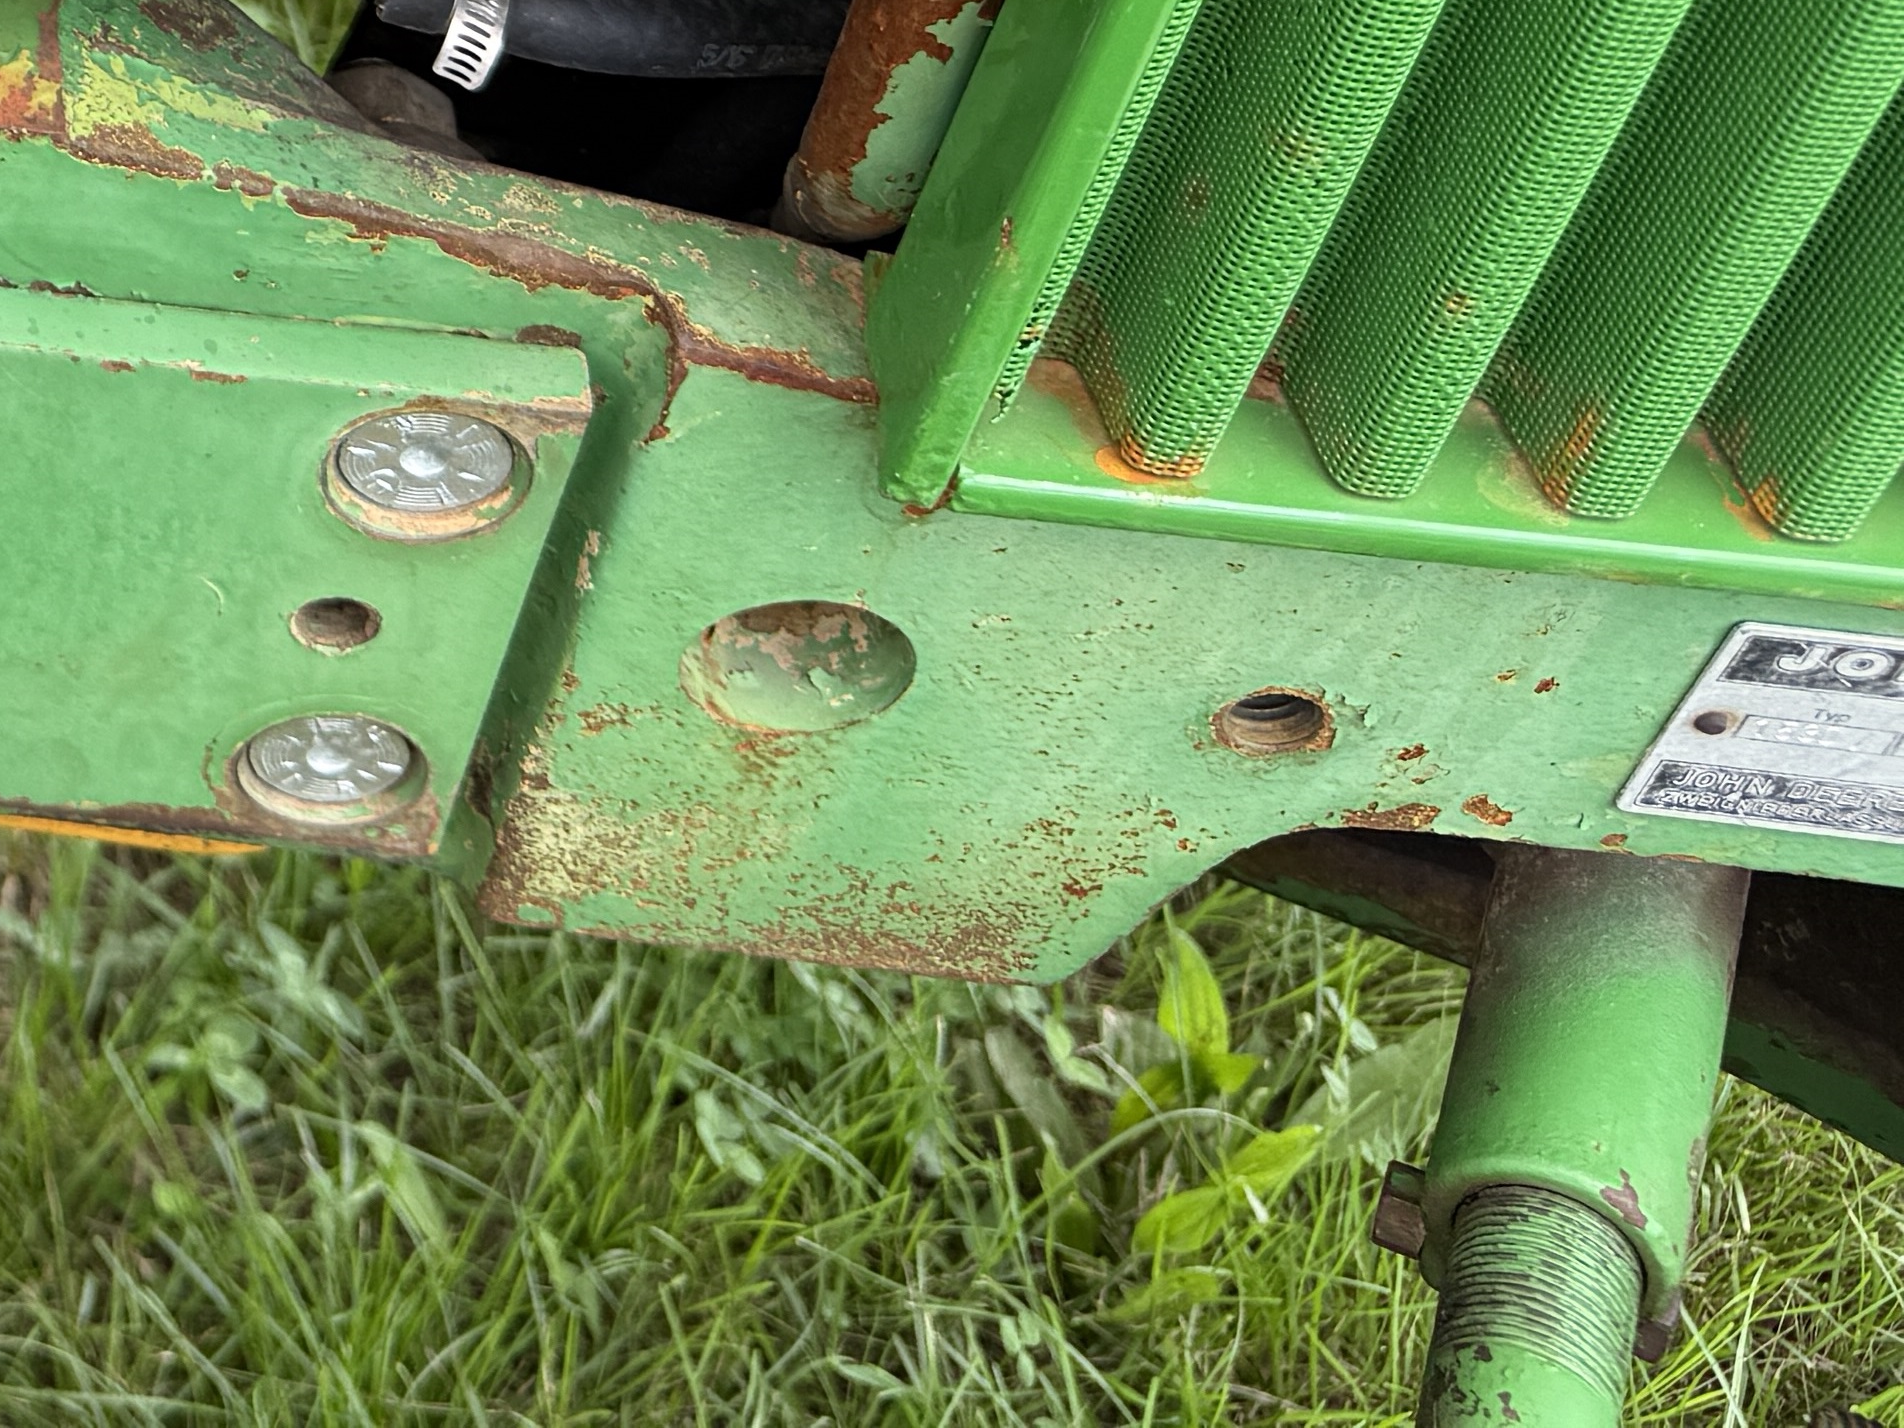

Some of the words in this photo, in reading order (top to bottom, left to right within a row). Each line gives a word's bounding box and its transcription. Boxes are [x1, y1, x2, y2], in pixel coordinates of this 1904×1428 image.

[1775, 644, 1904, 682] JO
[1813, 707, 1852, 724] Typ
[1671, 768, 1773, 796] JOHN
